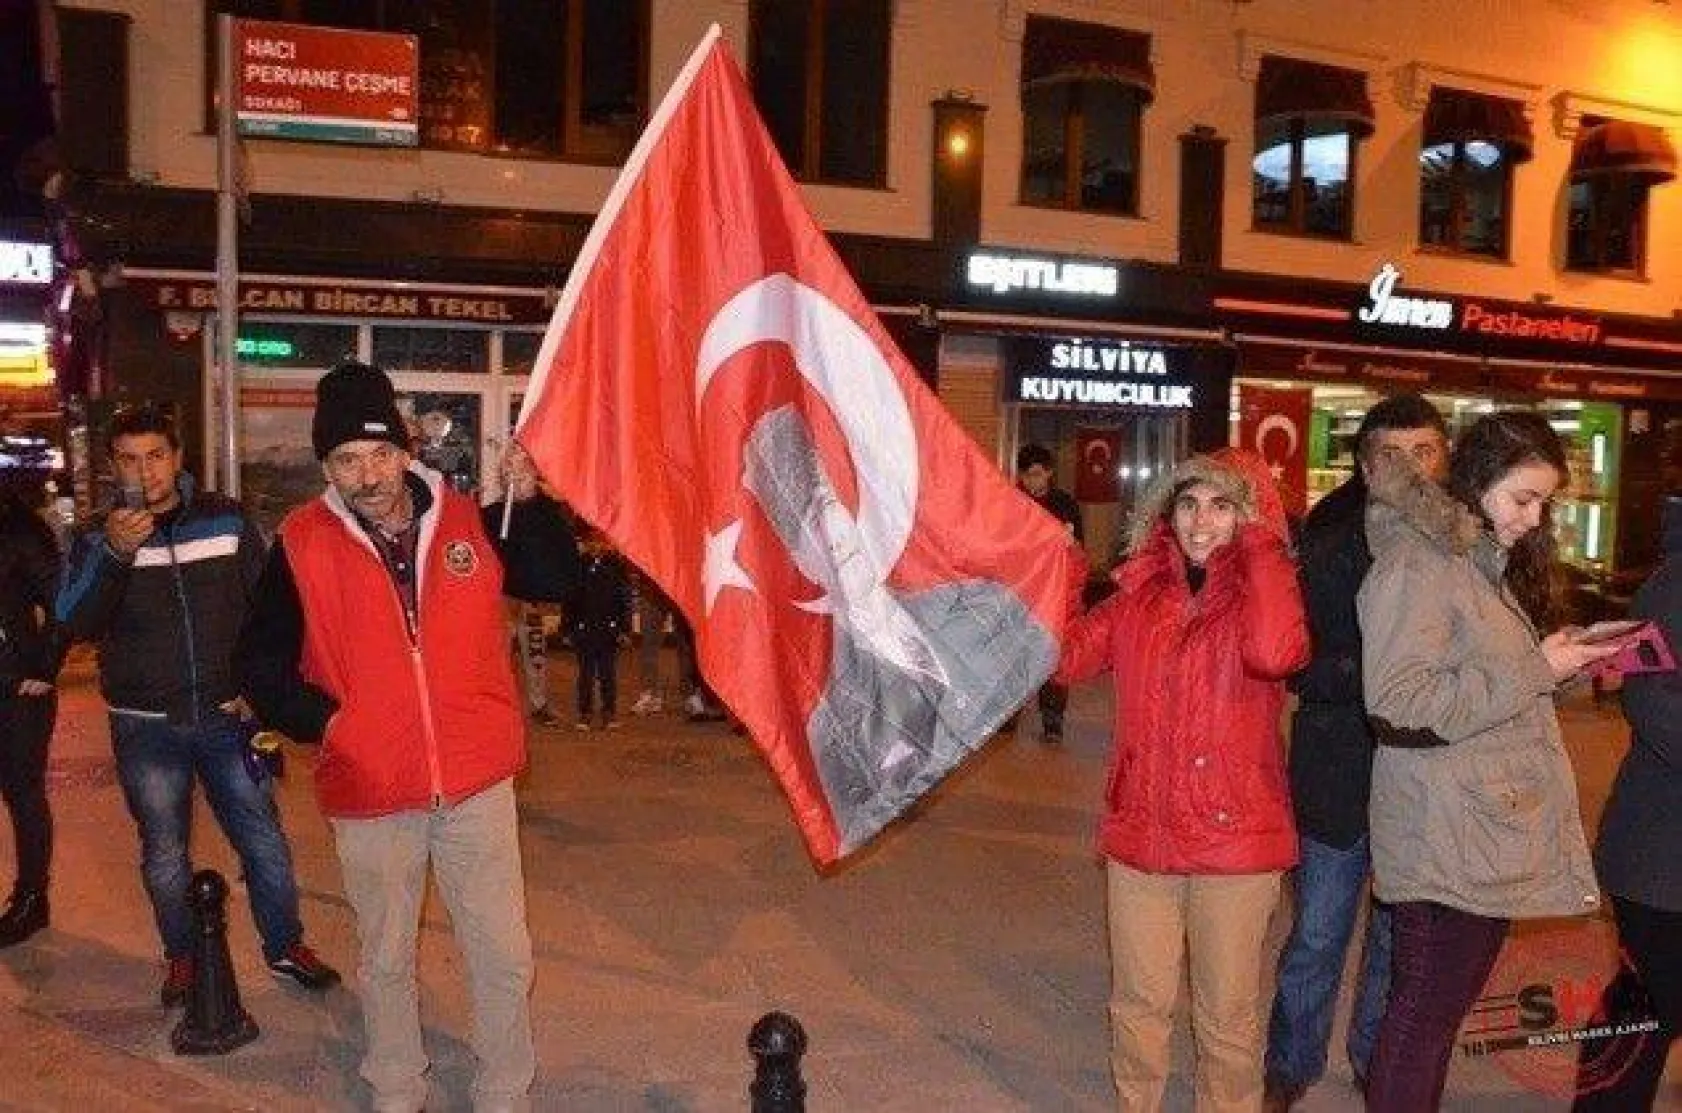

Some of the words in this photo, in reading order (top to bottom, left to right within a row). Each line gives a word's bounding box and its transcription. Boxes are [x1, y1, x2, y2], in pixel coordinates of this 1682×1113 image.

[245, 39, 297, 59] HACI
[245, 64, 341, 89] PERVANE
[429, 297, 514, 321] TEKEL
[1051, 338, 1167, 374] SİLVİYA
[1021, 377, 1194, 408] KUYUMCULUK
